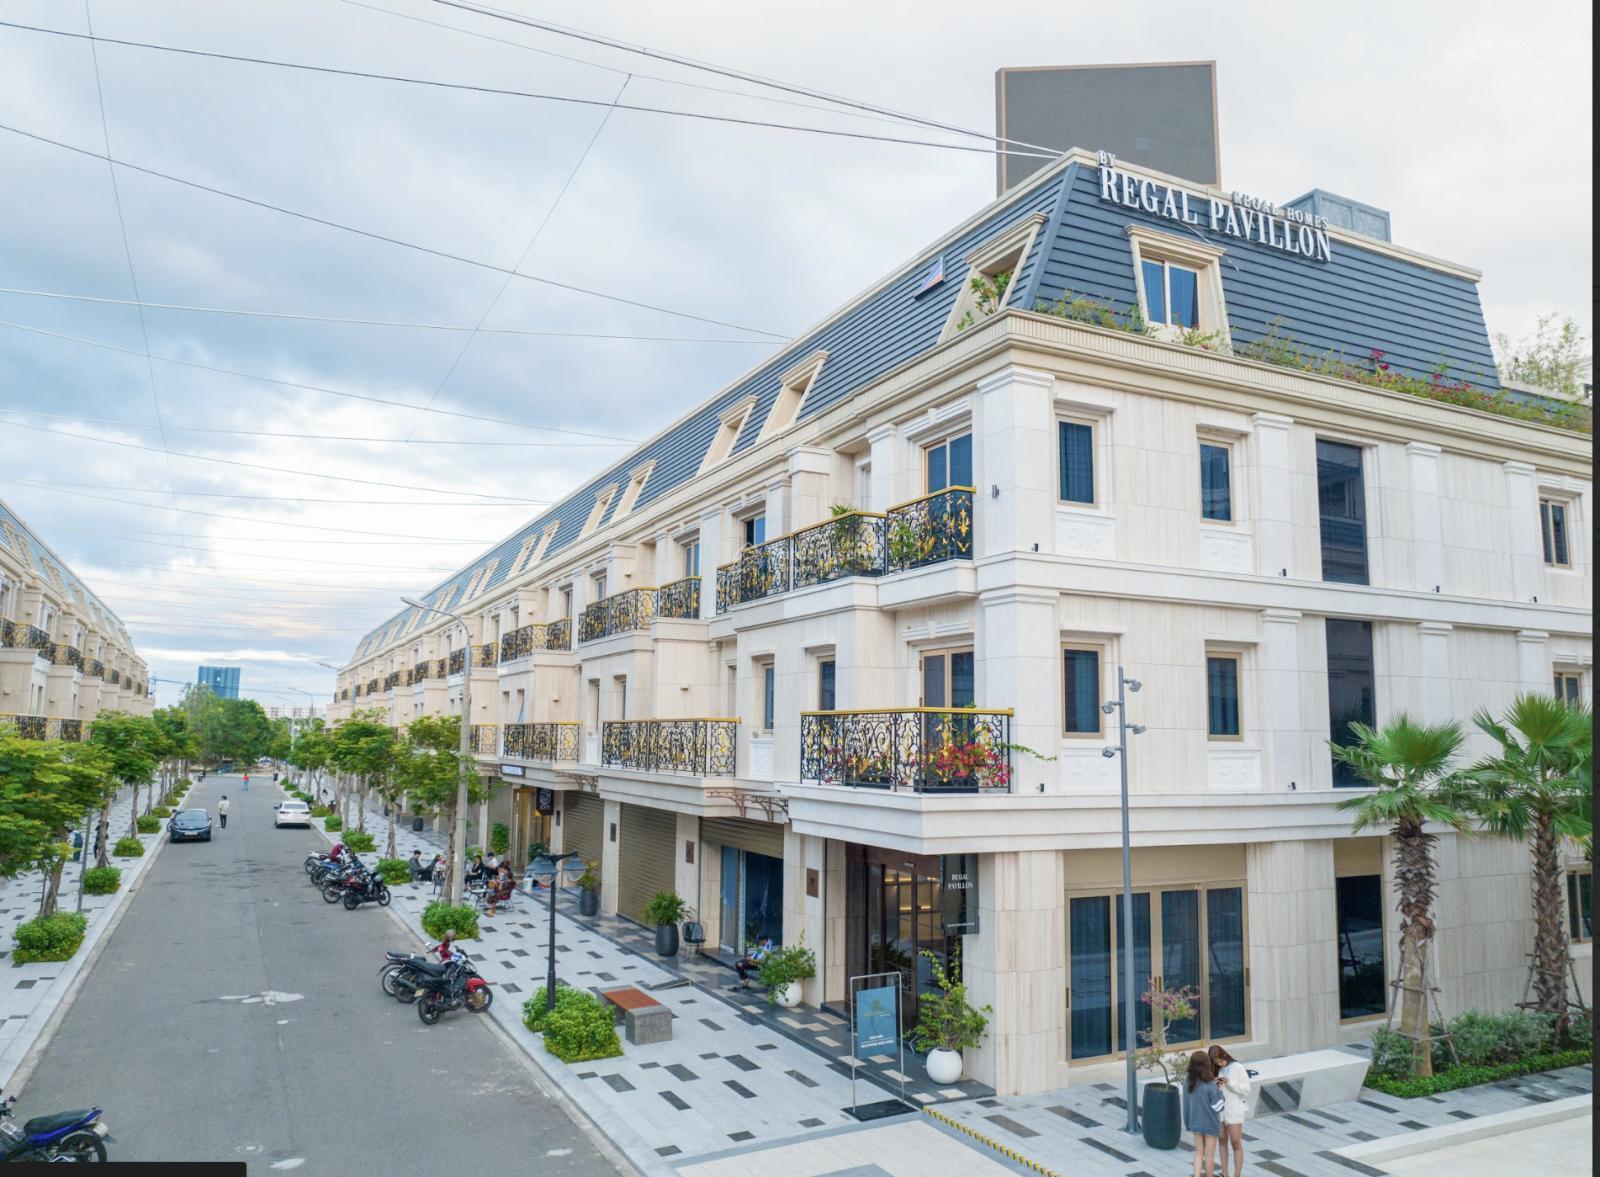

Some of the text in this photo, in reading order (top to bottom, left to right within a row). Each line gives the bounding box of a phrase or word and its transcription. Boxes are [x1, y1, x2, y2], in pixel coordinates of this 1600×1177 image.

[1098, 149, 1329, 230] BY REGAL HOMES
[1099, 166, 1331, 262] REGAL PAVILLON
